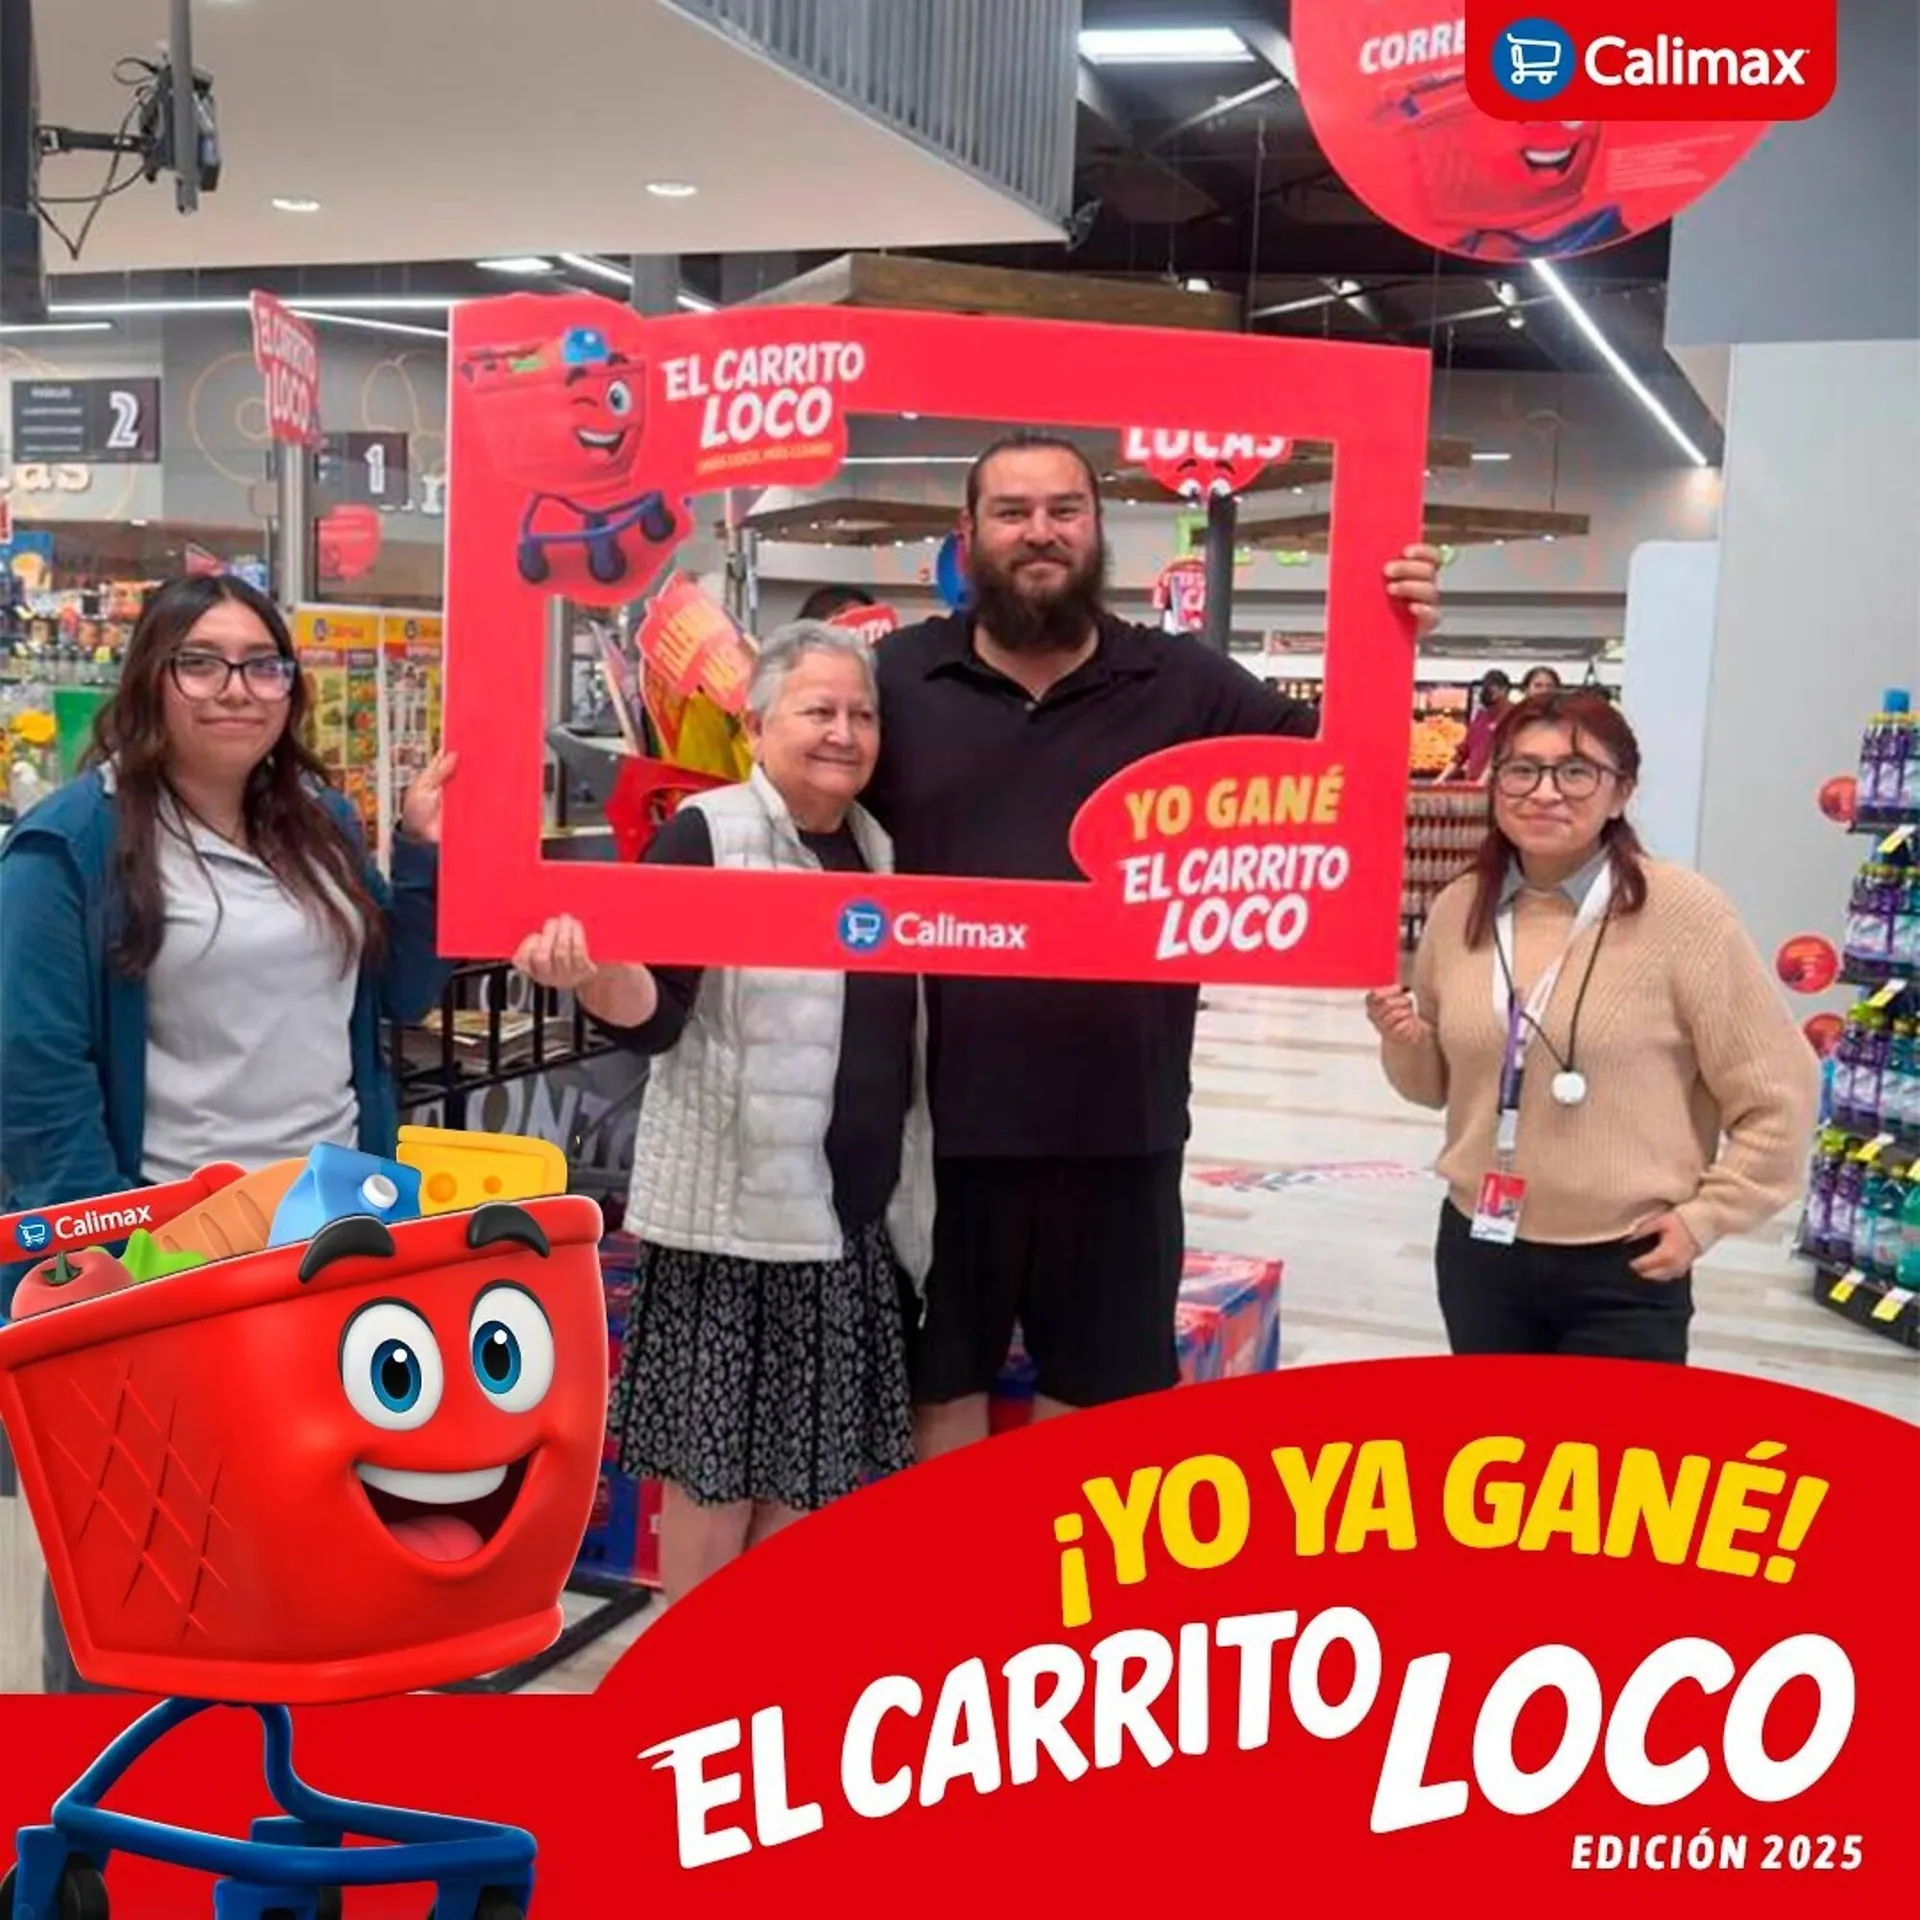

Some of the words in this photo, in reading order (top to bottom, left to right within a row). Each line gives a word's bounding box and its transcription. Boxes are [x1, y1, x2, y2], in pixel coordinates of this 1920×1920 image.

[660, 354, 709, 401] EL
[712, 341, 865, 394] CARRITO
[106, 391, 140, 449] 2
[701, 385, 833, 450] LOCO
[364, 443, 386, 495] 1
[1124, 785, 1193, 842] YO
[1205, 764, 1346, 829] GANÉ
[1116, 852, 1172, 904] EL
[1177, 844, 1350, 896] CARRITO
[893, 911, 1029, 949] Calimax
[1155, 893, 1309, 961] LOCO
